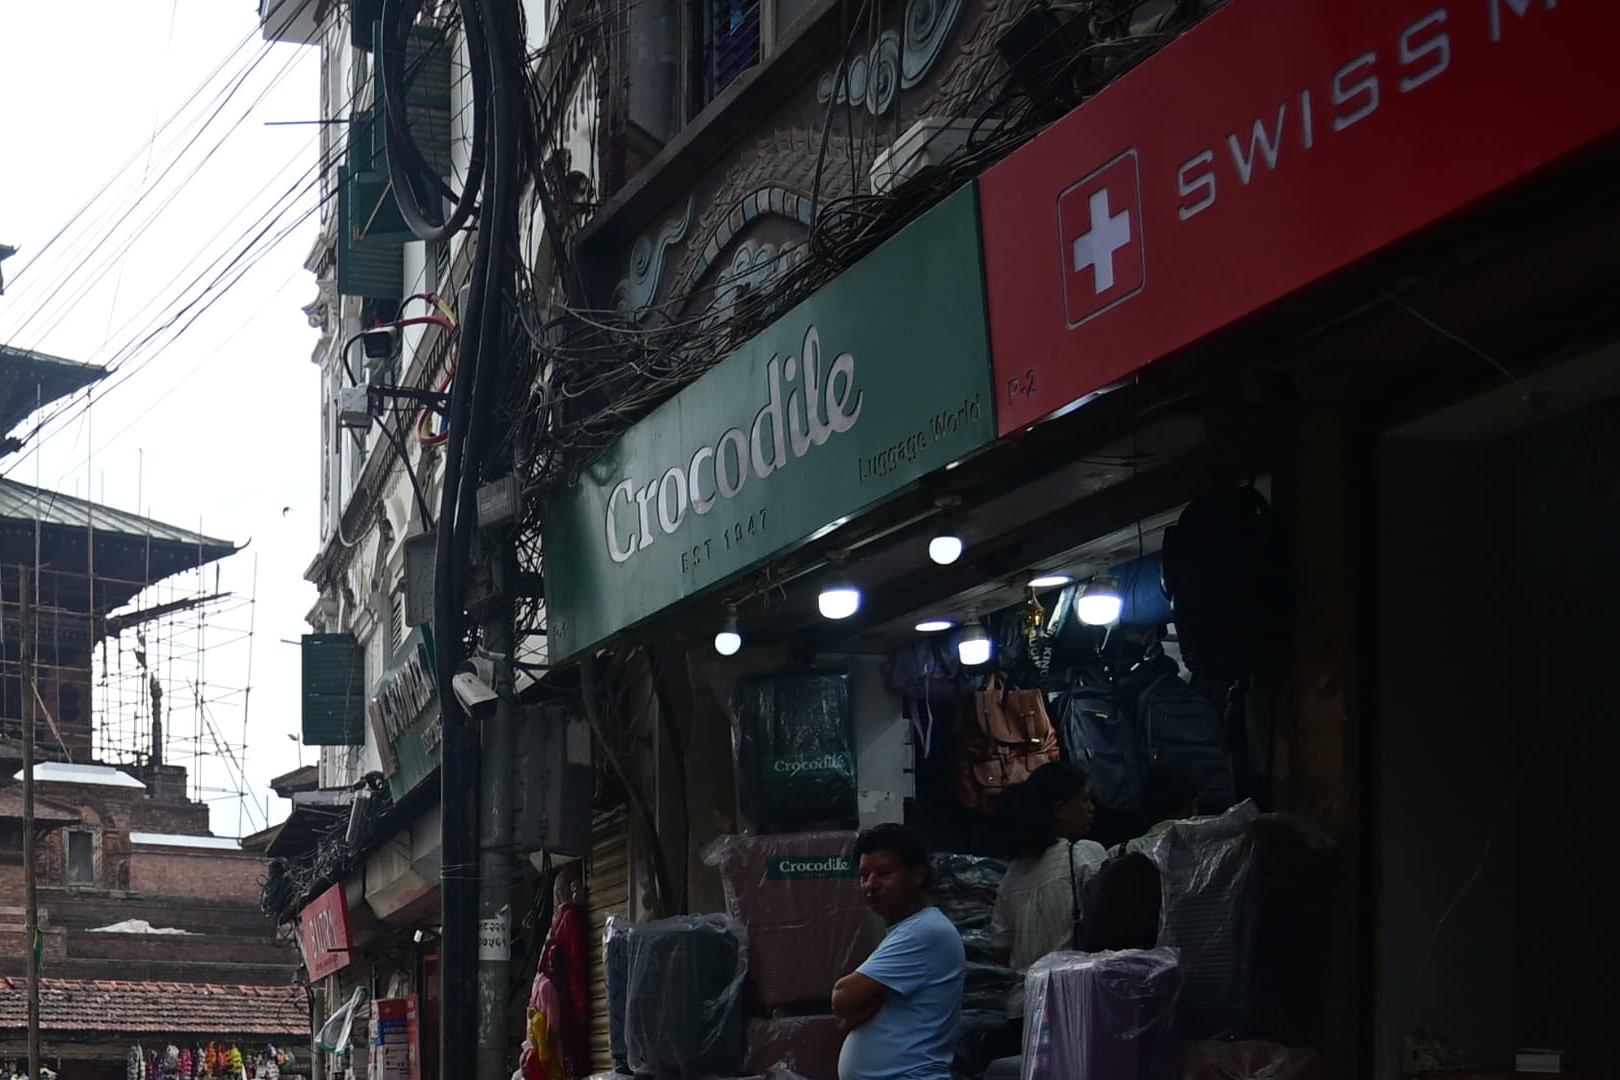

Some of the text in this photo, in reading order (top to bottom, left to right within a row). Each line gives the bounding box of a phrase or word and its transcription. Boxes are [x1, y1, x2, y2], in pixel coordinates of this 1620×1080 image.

[1177, 8, 1451, 221] SWISS
[605, 324, 863, 563] Crocodile
[857, 393, 981, 482] Luggage World
[680, 539, 712, 574] EST
[774, 754, 845, 773] Crocodile
[779, 857, 850, 873] Crocodile
